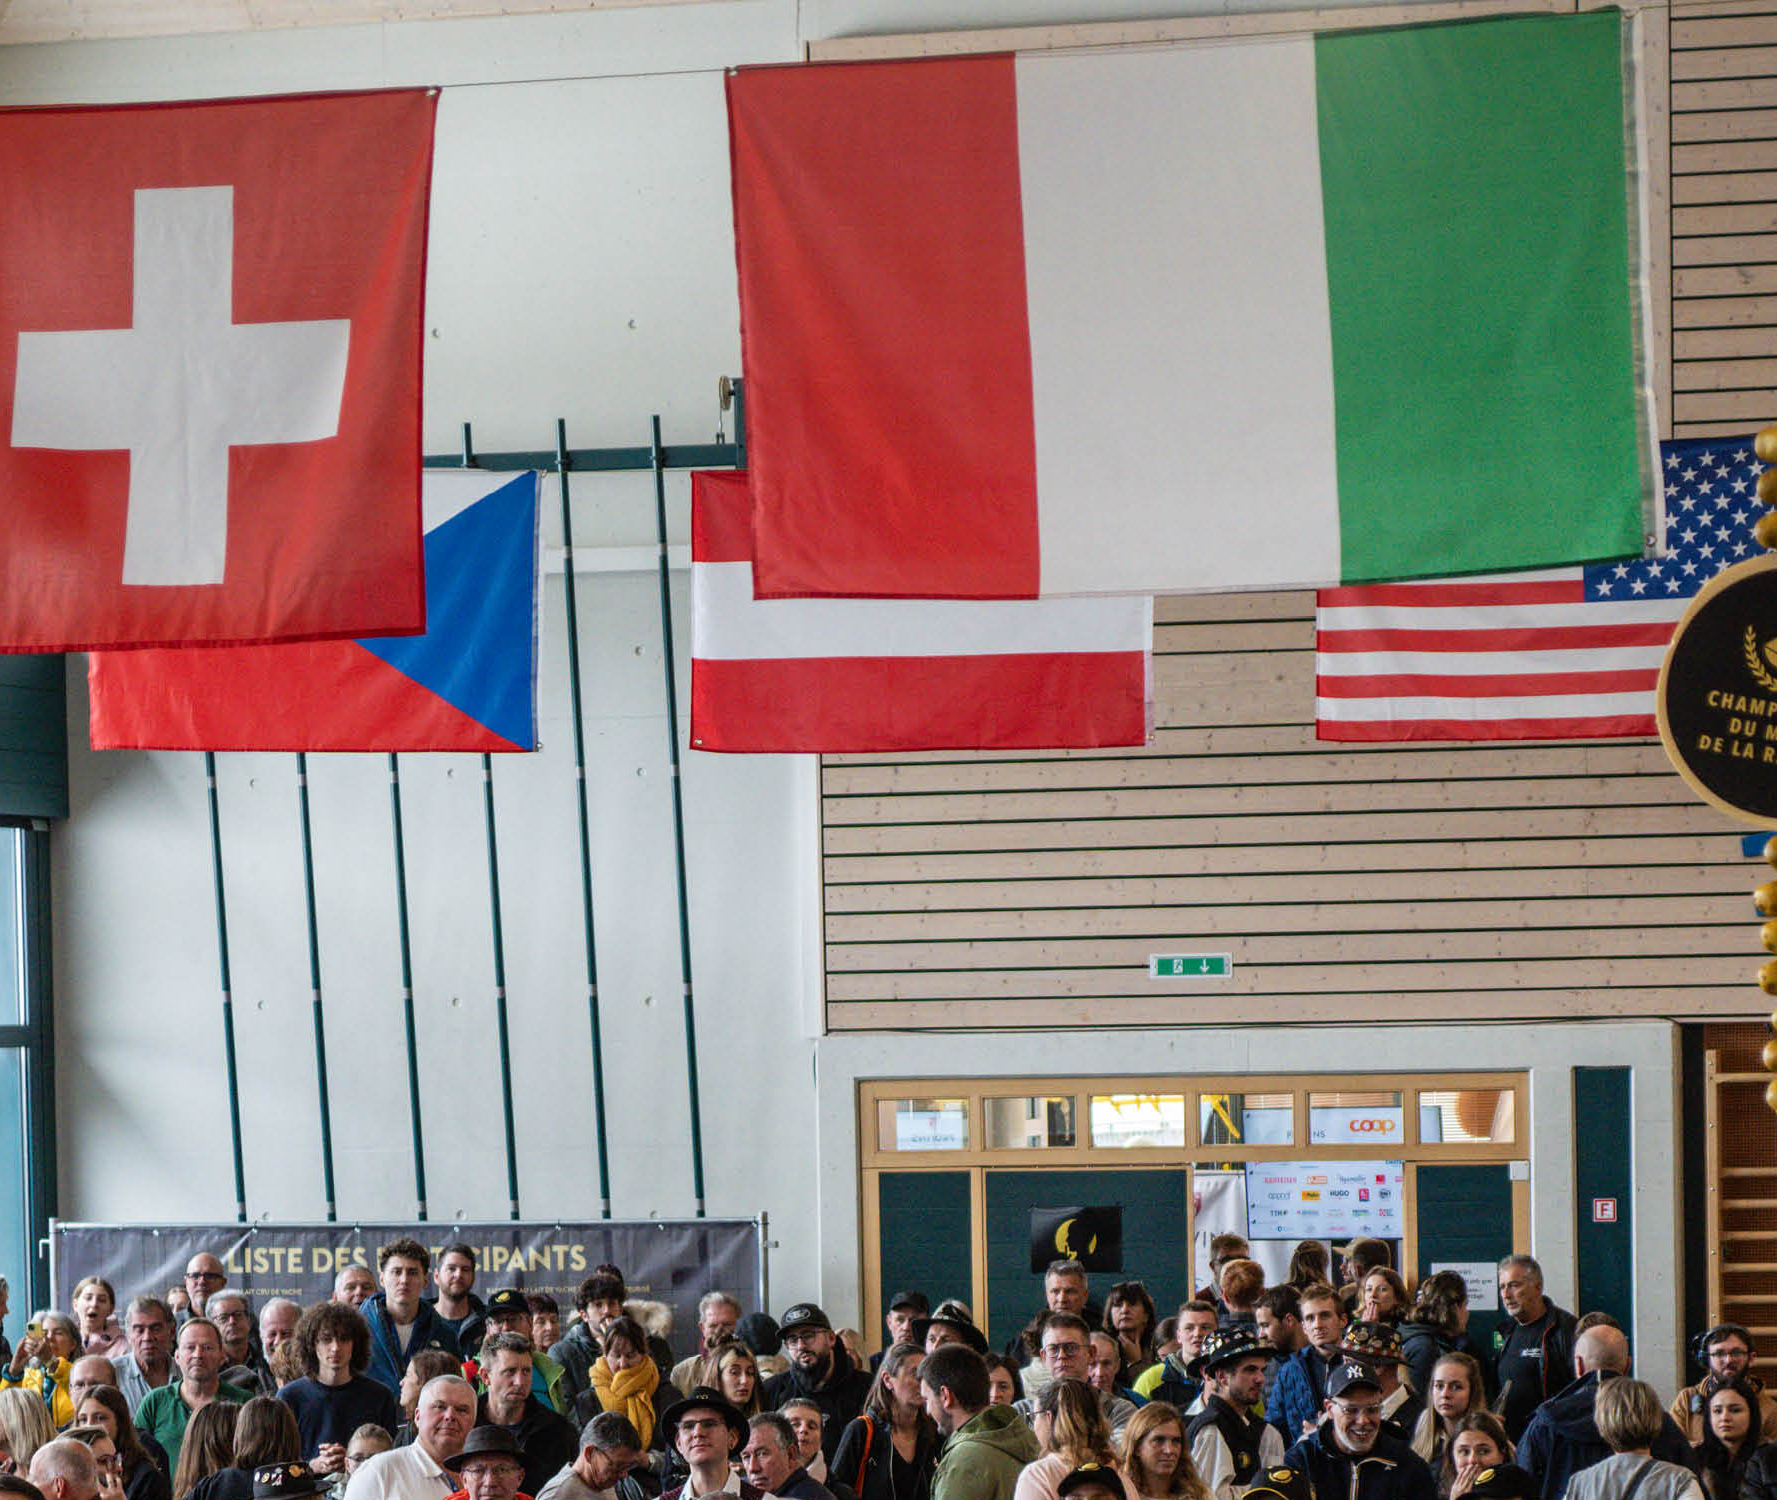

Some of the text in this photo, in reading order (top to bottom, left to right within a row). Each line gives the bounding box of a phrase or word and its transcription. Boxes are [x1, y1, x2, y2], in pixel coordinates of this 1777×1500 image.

[1729, 717, 1757, 737] DU
[1699, 735, 1723, 753] DE
[1732, 740, 1755, 759] LA
[1350, 1119, 1395, 1135] coop
[1329, 1189, 1350, 1197] HUGO
[1600, 1202, 1610, 1217] F
[227, 1247, 304, 1274] LISTE
[312, 1246, 369, 1274] DES
